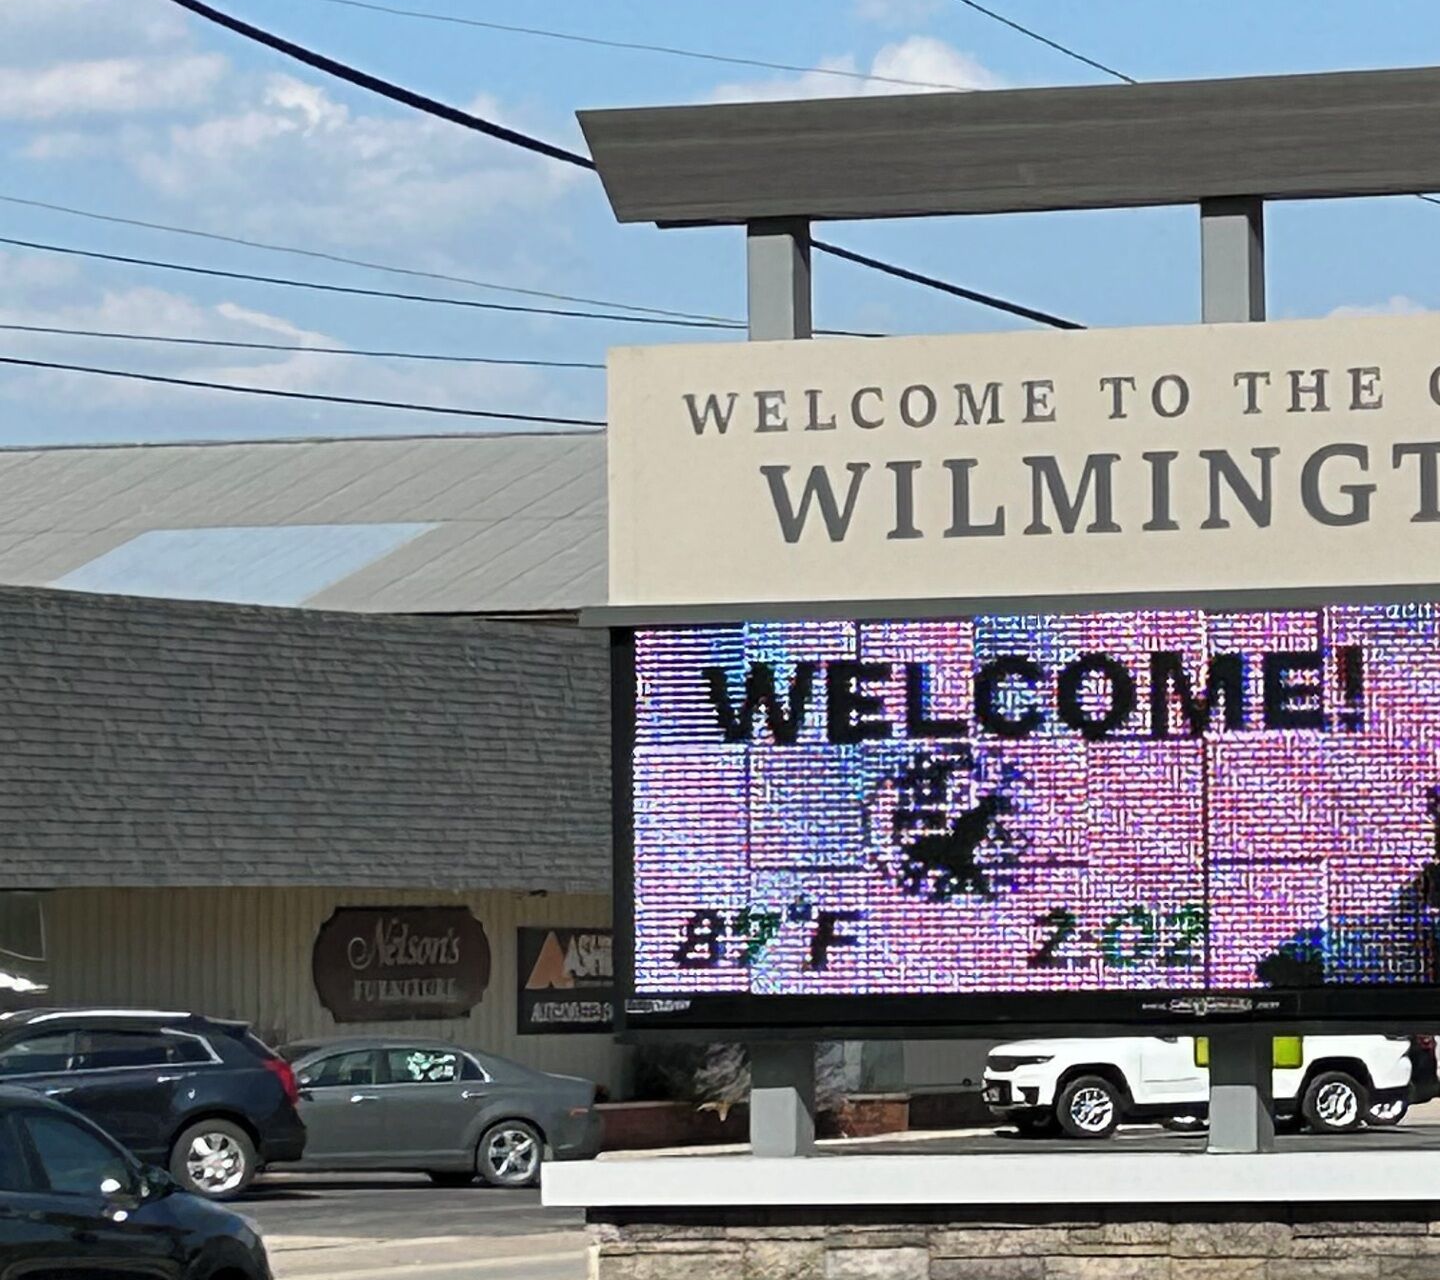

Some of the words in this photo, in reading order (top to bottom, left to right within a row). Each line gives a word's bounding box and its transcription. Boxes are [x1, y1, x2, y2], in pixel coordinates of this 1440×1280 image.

[683, 379, 1058, 437] WELCOME
[1098, 375, 1192, 422] TO
[1234, 367, 1384, 416] THE
[702, 644, 1364, 744] WELCOME!
[347, 918, 460, 970] Nelson's
